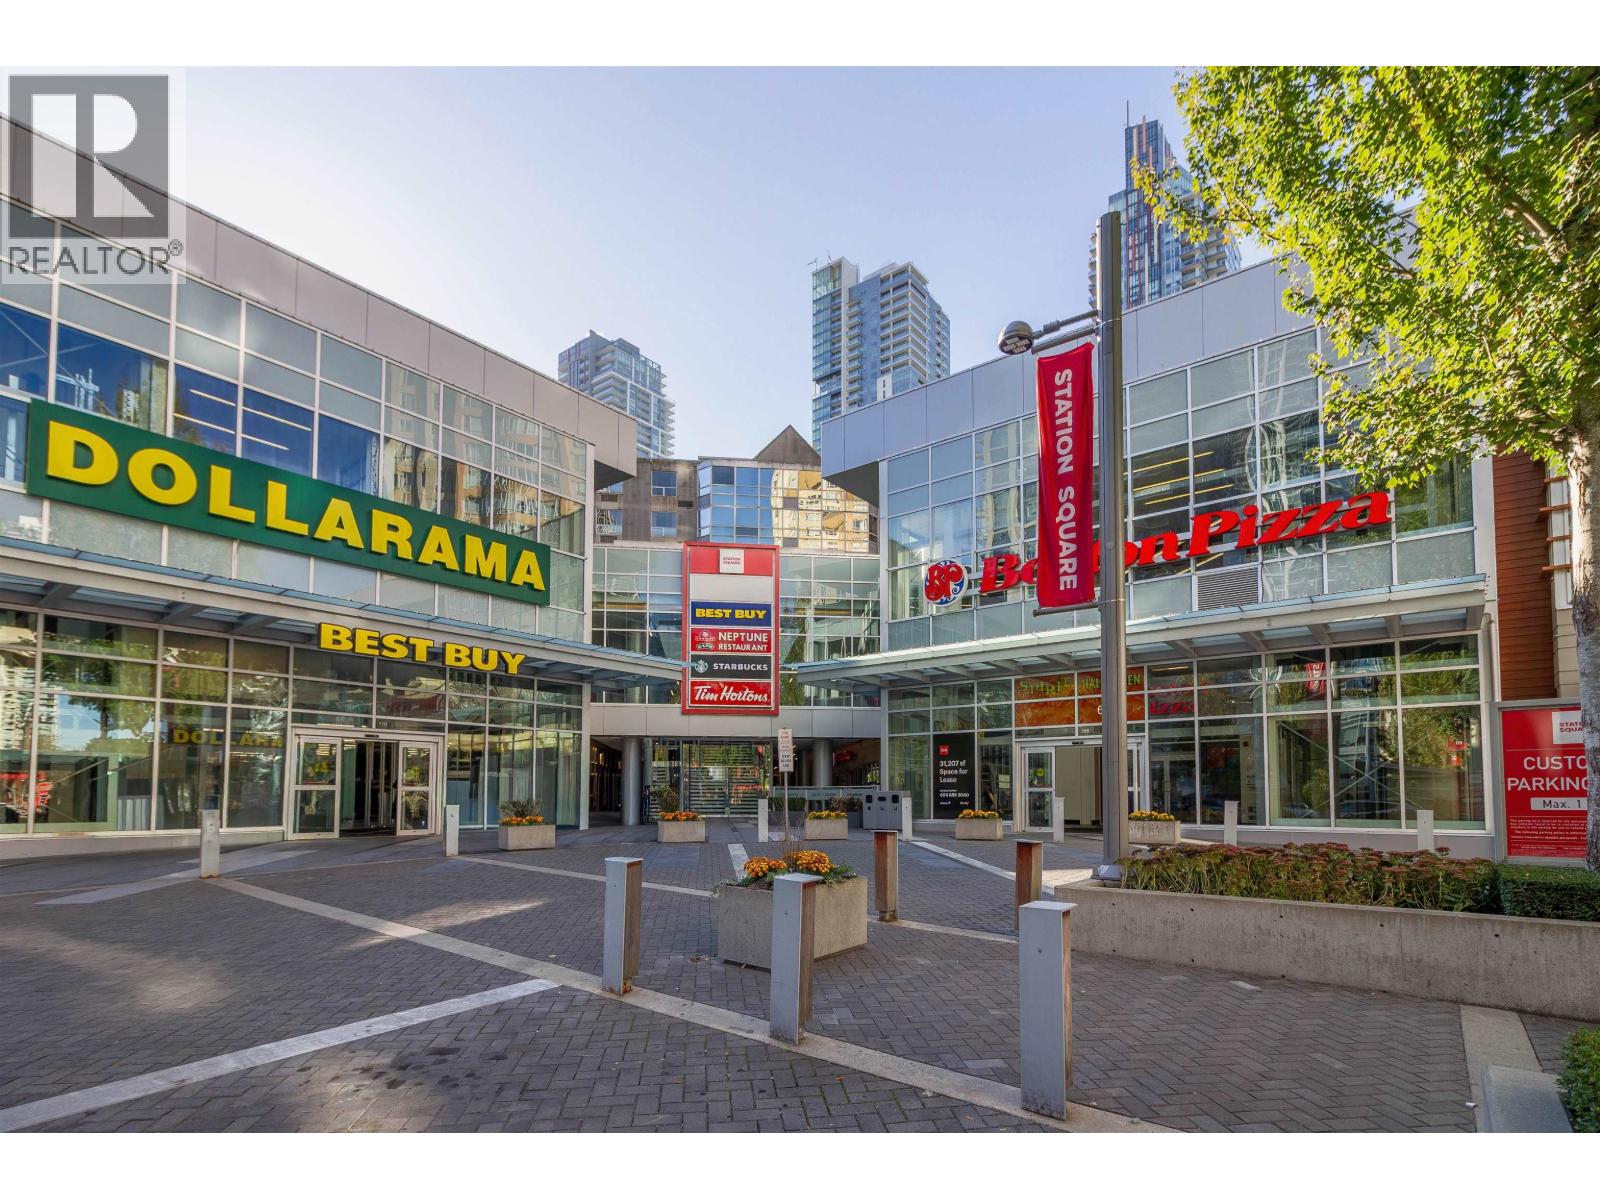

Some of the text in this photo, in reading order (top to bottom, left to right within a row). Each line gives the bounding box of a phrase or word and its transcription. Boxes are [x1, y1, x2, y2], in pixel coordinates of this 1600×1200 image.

[1054, 368, 1077, 590] STATION SQUARE
[47, 419, 546, 592] DOLLARAMA
[1186, 491, 1392, 557] Pizza
[695, 608, 767, 619] BEST BUY
[718, 632, 768, 642] NEPTUNE
[318, 622, 527, 676] BEST BUY
[718, 643, 768, 651] RESTAURANT
[713, 663, 768, 671] STARBUCKS
[694, 685, 768, 702] Tim Hortons
[939, 760, 959, 768] 31,207
[1523, 755, 1588, 770] CUSTO
[939, 768, 958, 776] Space
[1543, 799, 1571, 809] Max.
